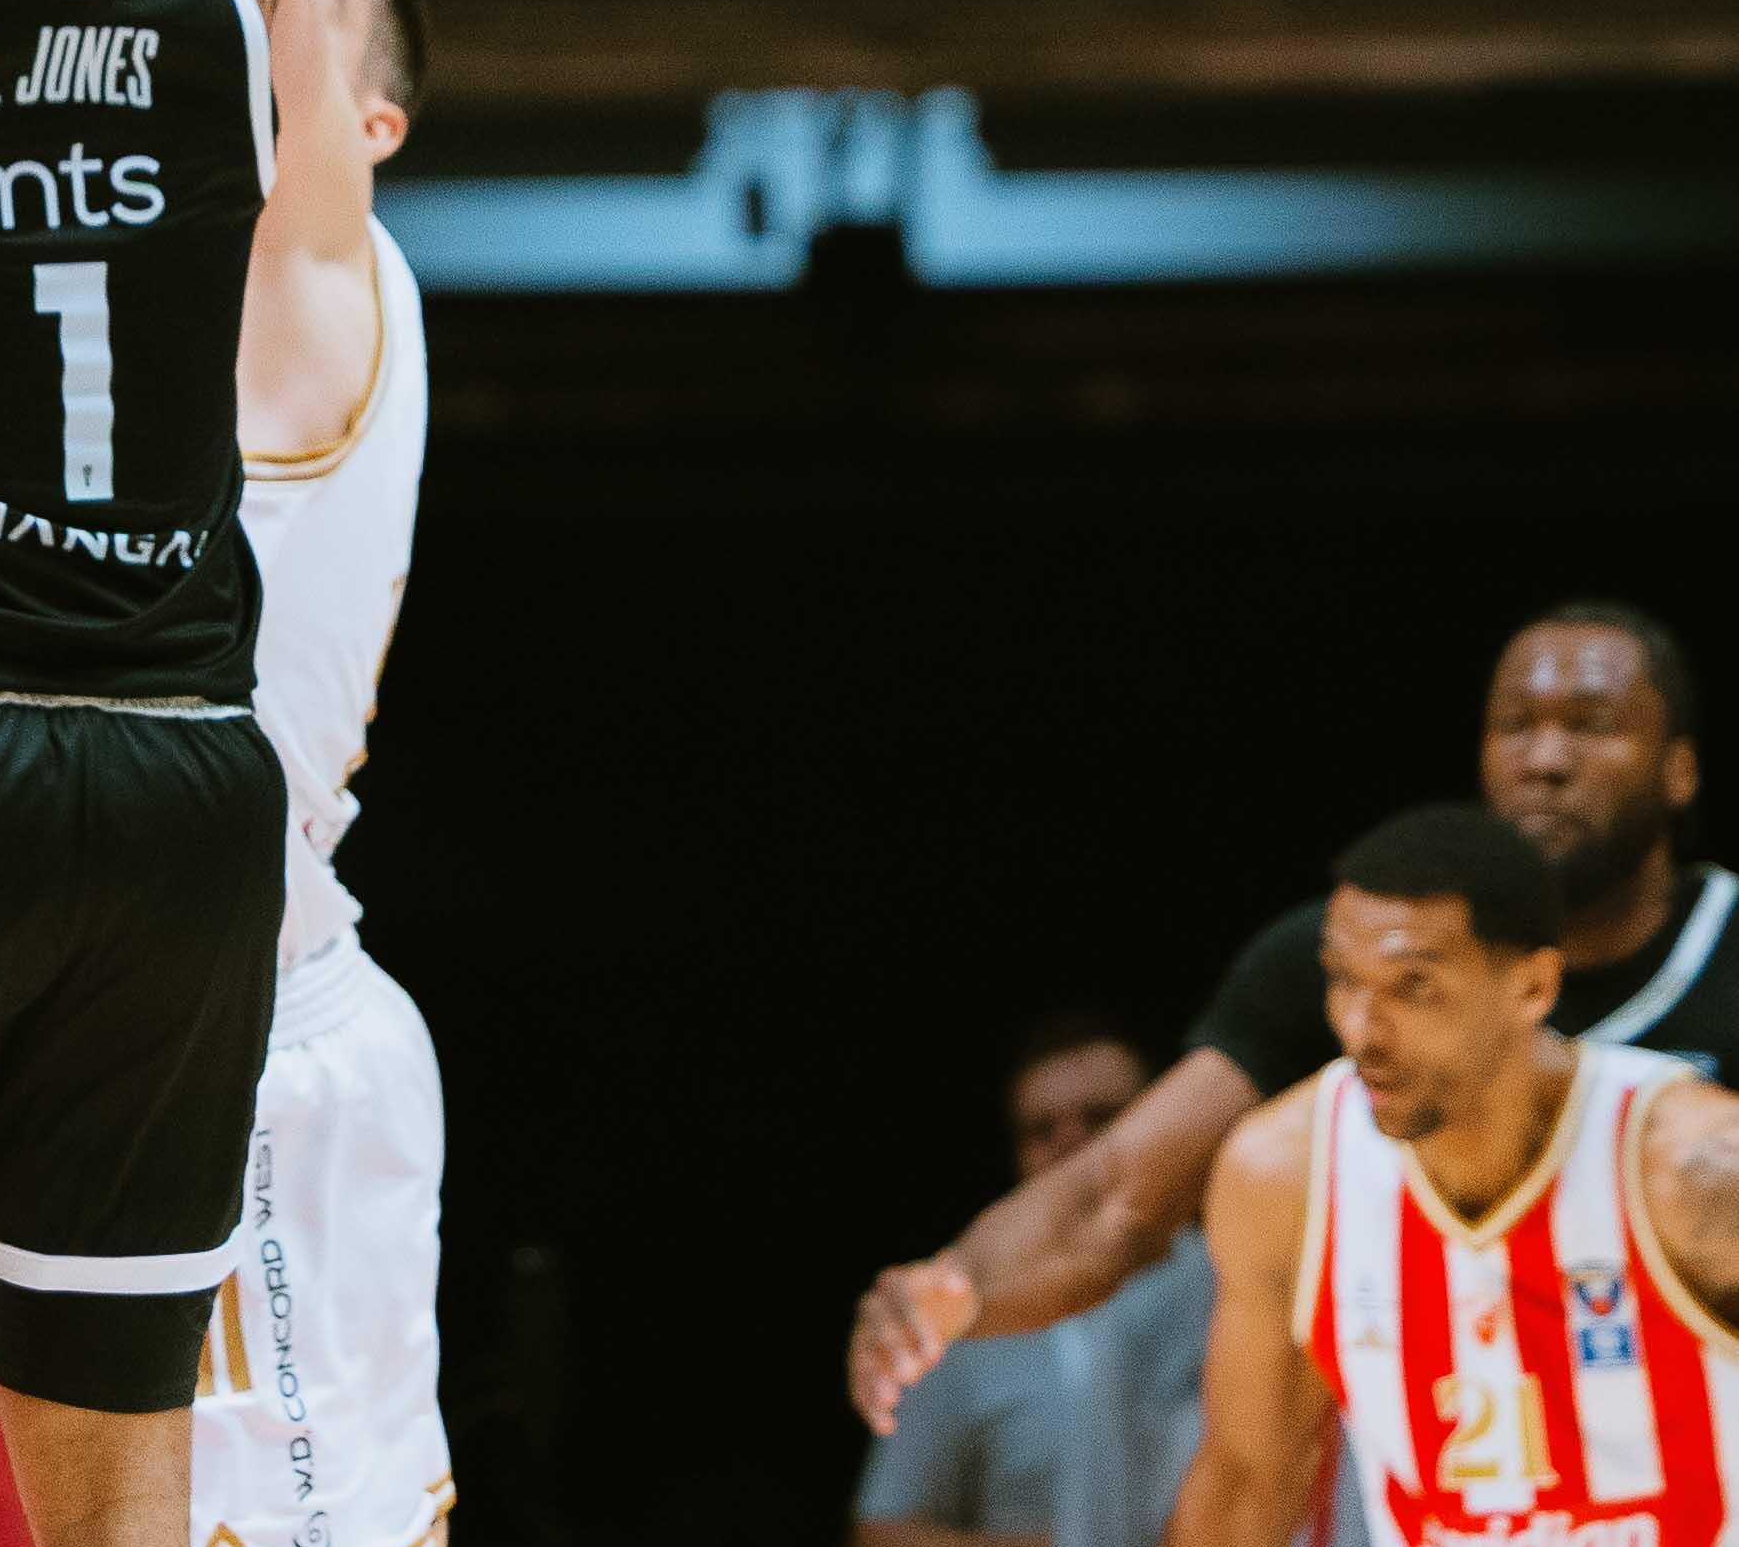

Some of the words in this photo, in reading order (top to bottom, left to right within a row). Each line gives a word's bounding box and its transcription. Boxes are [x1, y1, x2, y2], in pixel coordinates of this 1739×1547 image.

[15, 25, 160, 109] JONES
[33, 260, 114, 504] 1
[261, 1238, 306, 1423] CONCORD
[1431, 1372, 1560, 1493] 21
